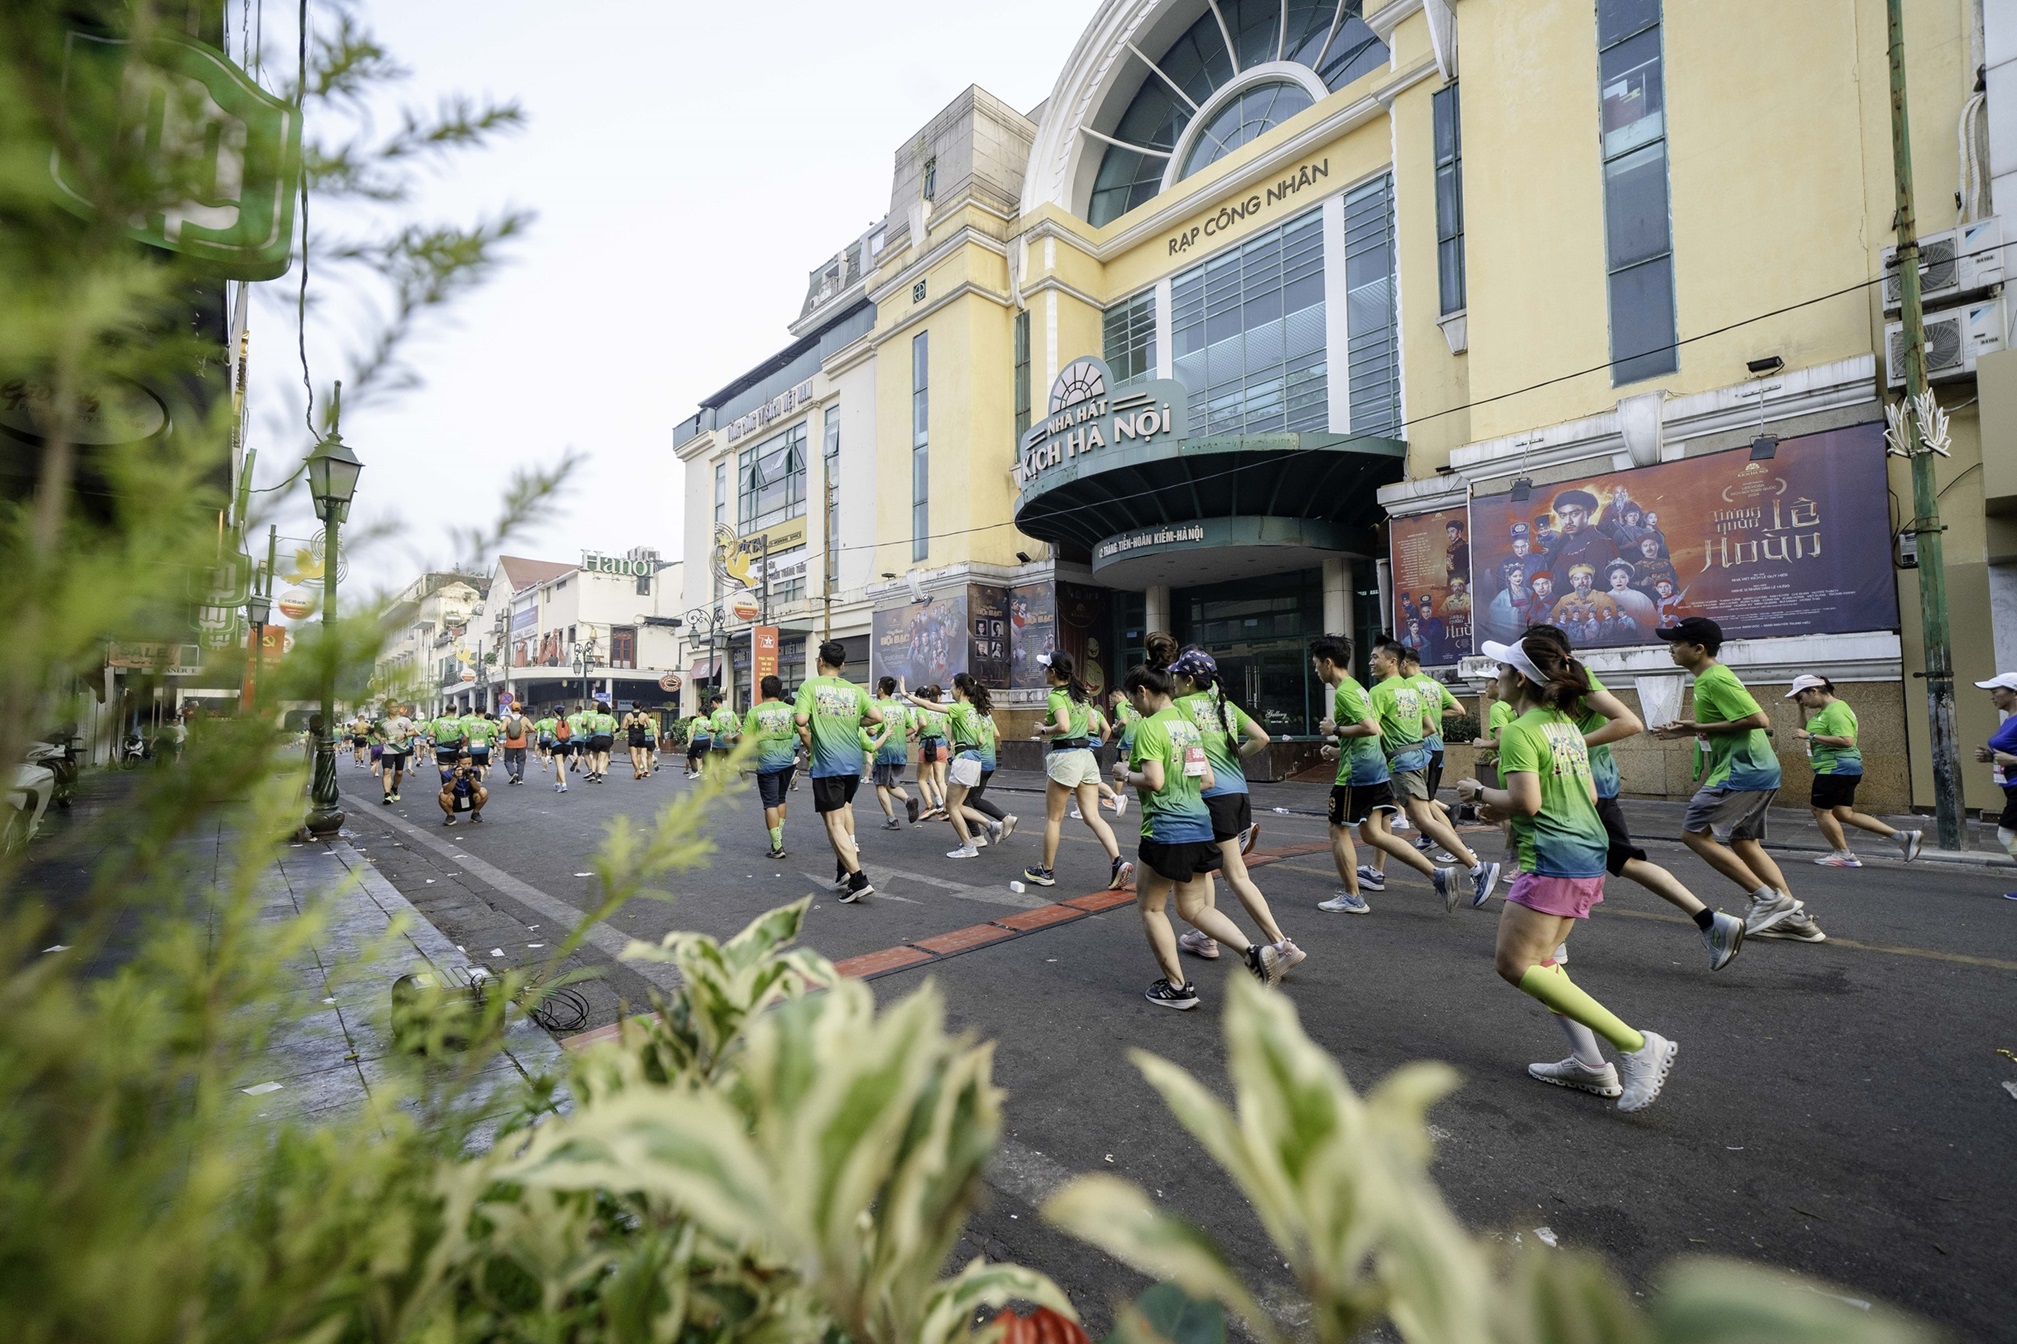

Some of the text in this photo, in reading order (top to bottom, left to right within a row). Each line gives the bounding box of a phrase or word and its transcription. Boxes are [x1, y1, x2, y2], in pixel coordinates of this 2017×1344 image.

[1168, 158, 1329, 256] RẠP CÔNG NHÂN
[765, 398, 782, 422] SÁCH
[782, 389, 796, 414] VIỆT
[796, 380, 813, 405] NAM
[1048, 398, 1109, 438] NHÀ HÁT
[1022, 402, 1171, 482] KỊCH HÀ NỘI
[1188, 524, 1204, 542] NỘI
[580, 548, 654, 577] Hanoi
